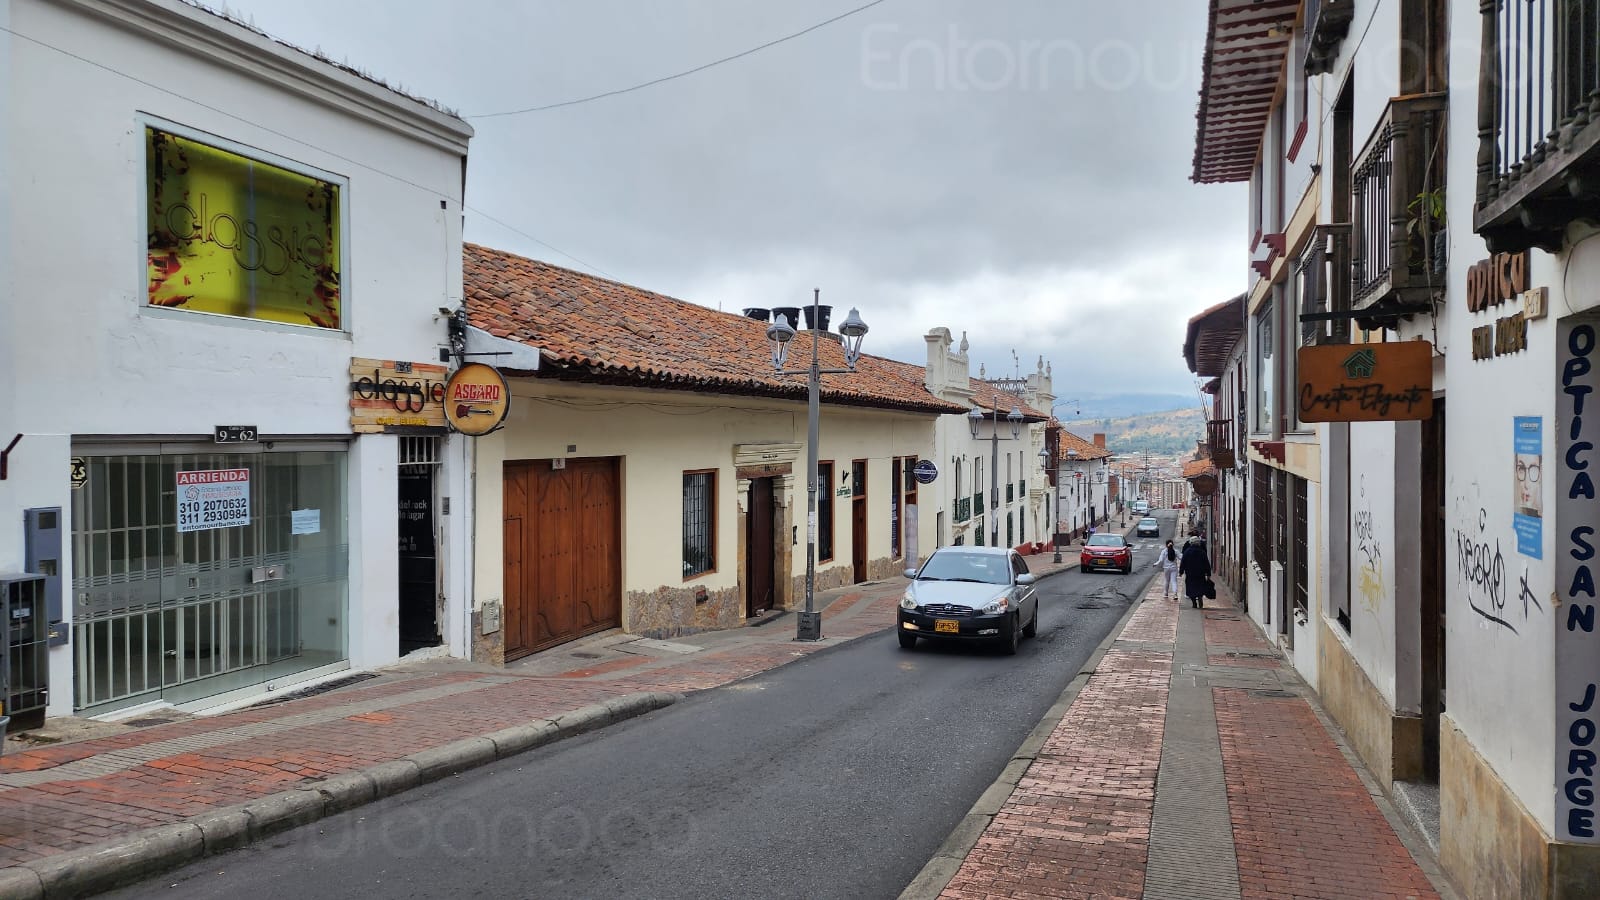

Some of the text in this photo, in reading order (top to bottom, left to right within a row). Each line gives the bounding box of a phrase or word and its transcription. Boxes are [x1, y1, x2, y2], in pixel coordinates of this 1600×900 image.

[454, 383, 500, 401] ASGARD
[220, 431, 227, 441] 9
[240, 431, 254, 441] 62
[179, 471, 247, 483] ARRIENDA
[180, 498, 247, 513] 310 2070632
[180, 509, 247, 524] 311 2930984
[1562, 325, 1597, 837] OPTICA SAN JORGE
